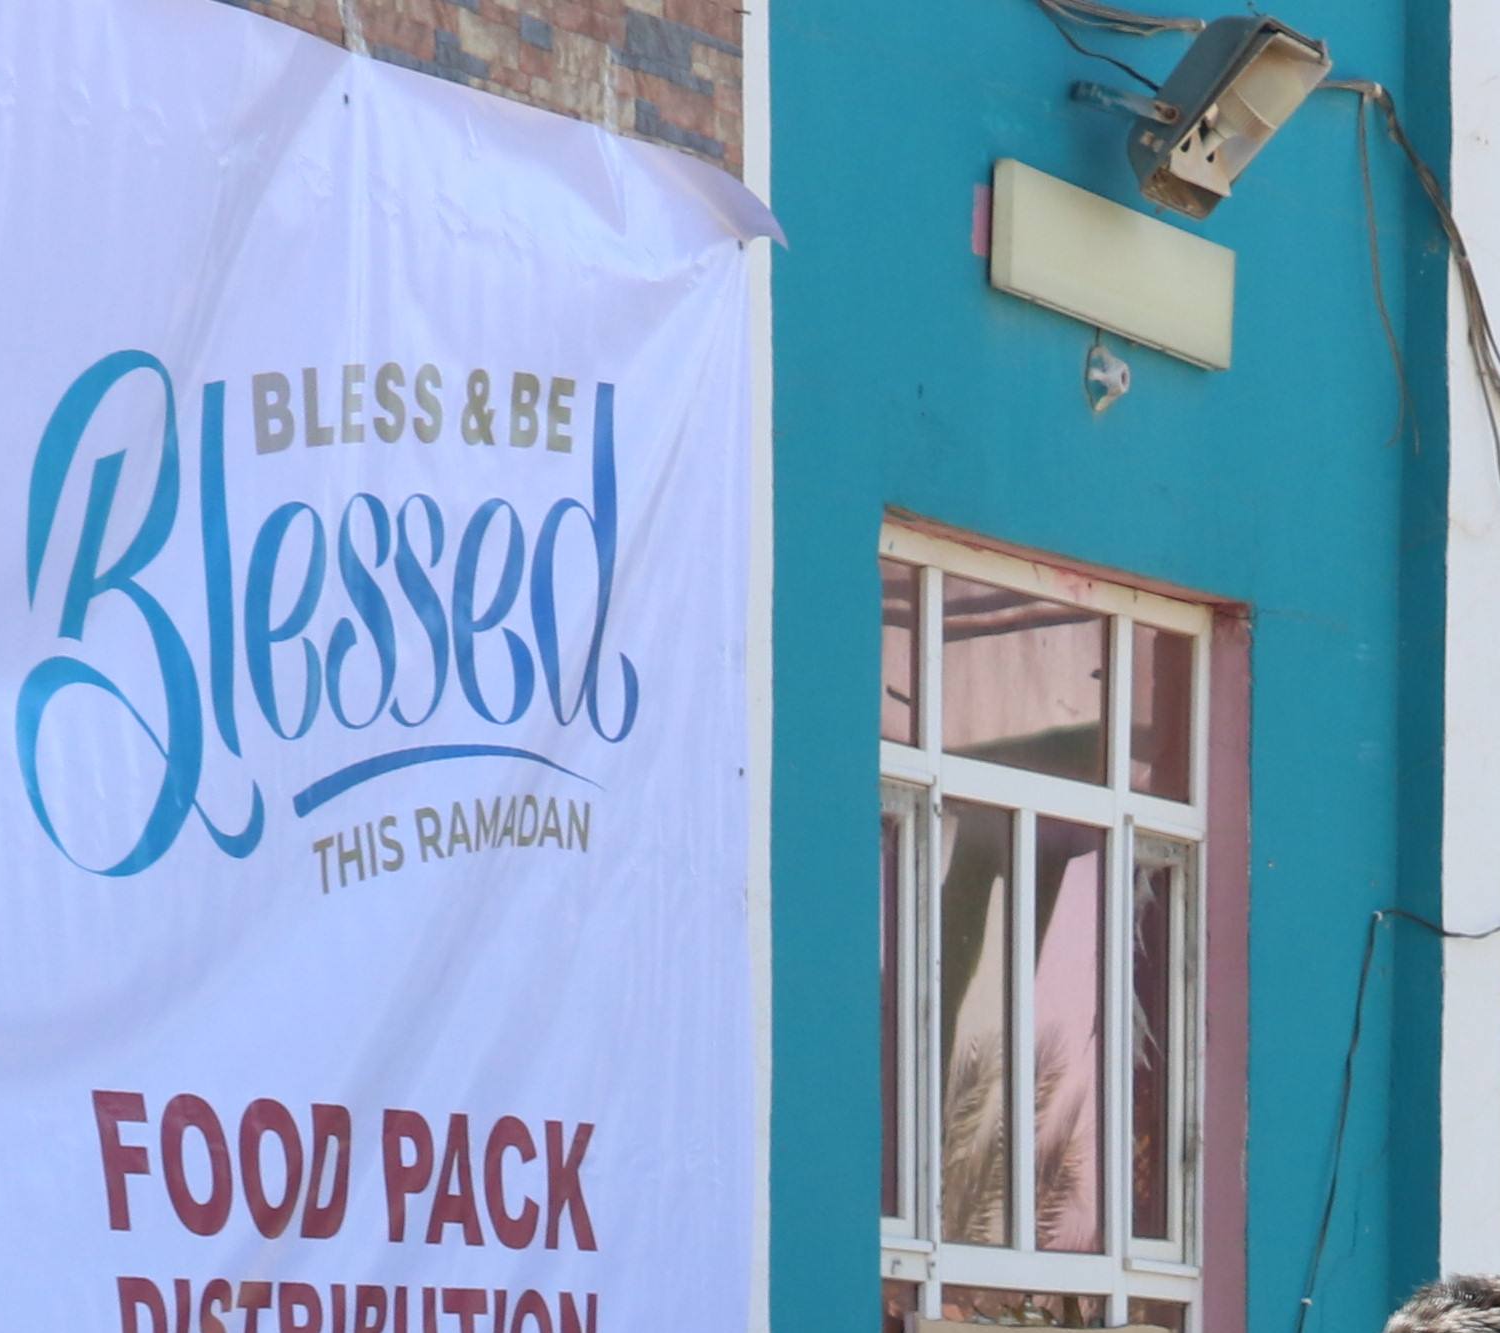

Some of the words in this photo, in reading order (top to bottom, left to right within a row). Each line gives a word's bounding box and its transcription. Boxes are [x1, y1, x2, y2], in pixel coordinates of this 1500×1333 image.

[251, 361, 444, 456] BLESS
[460, 367, 498, 447] &
[511, 371, 577, 454] BE
[15, 348, 640, 878] Blessed
[312, 814, 405, 895] THIS
[414, 795, 592, 863] RAMADAN
[91, 1088, 352, 1241] FOOD
[382, 1107, 599, 1252] PACK
